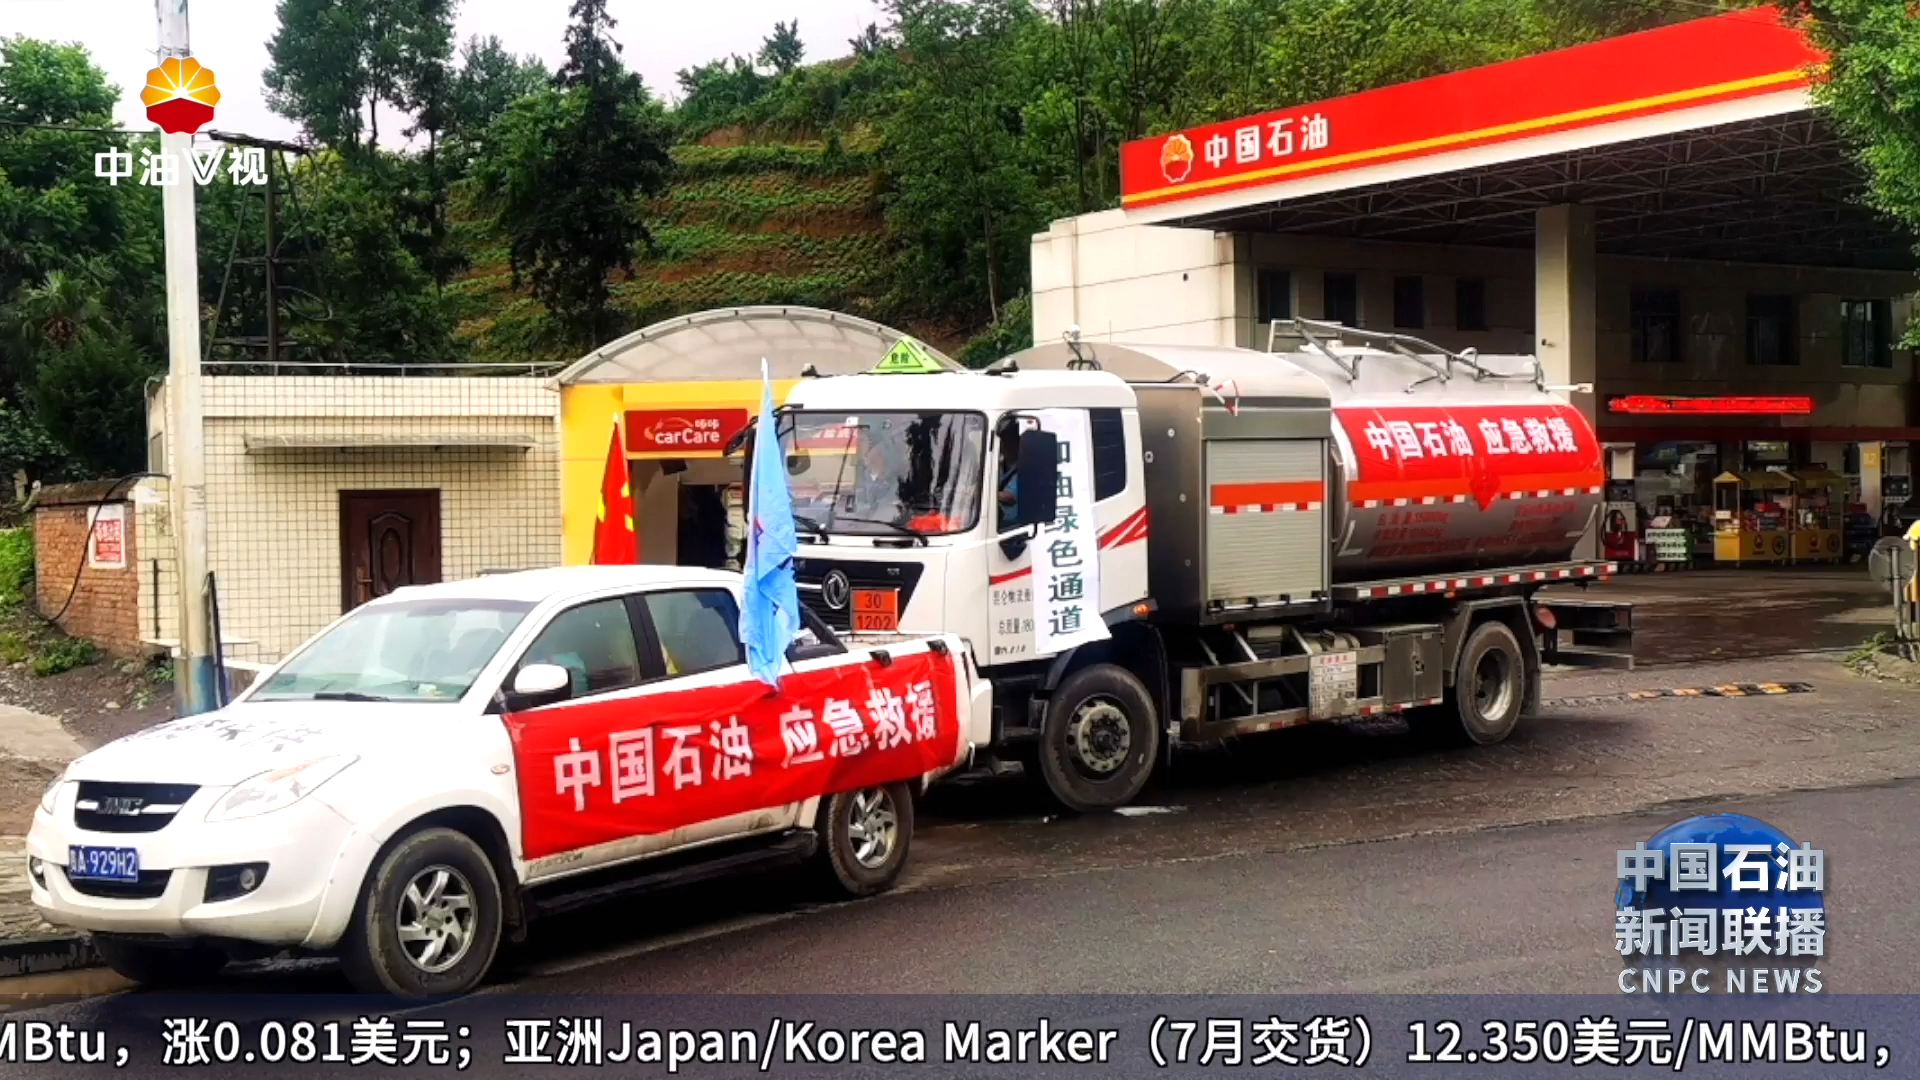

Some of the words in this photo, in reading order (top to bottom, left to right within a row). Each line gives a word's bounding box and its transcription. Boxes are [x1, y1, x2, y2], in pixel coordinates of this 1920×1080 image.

[1204, 112, 1328, 168] 中国石油
[891, 351, 910, 364] 危险
[655, 427, 720, 444] carCare
[1363, 415, 1475, 461] 中国石油
[1477, 416, 1579, 455] 应急救援
[864, 593, 882, 609] 30
[856, 615, 892, 630] 1202
[553, 715, 753, 812] 中国石油
[779, 680, 939, 769] 应急救援
